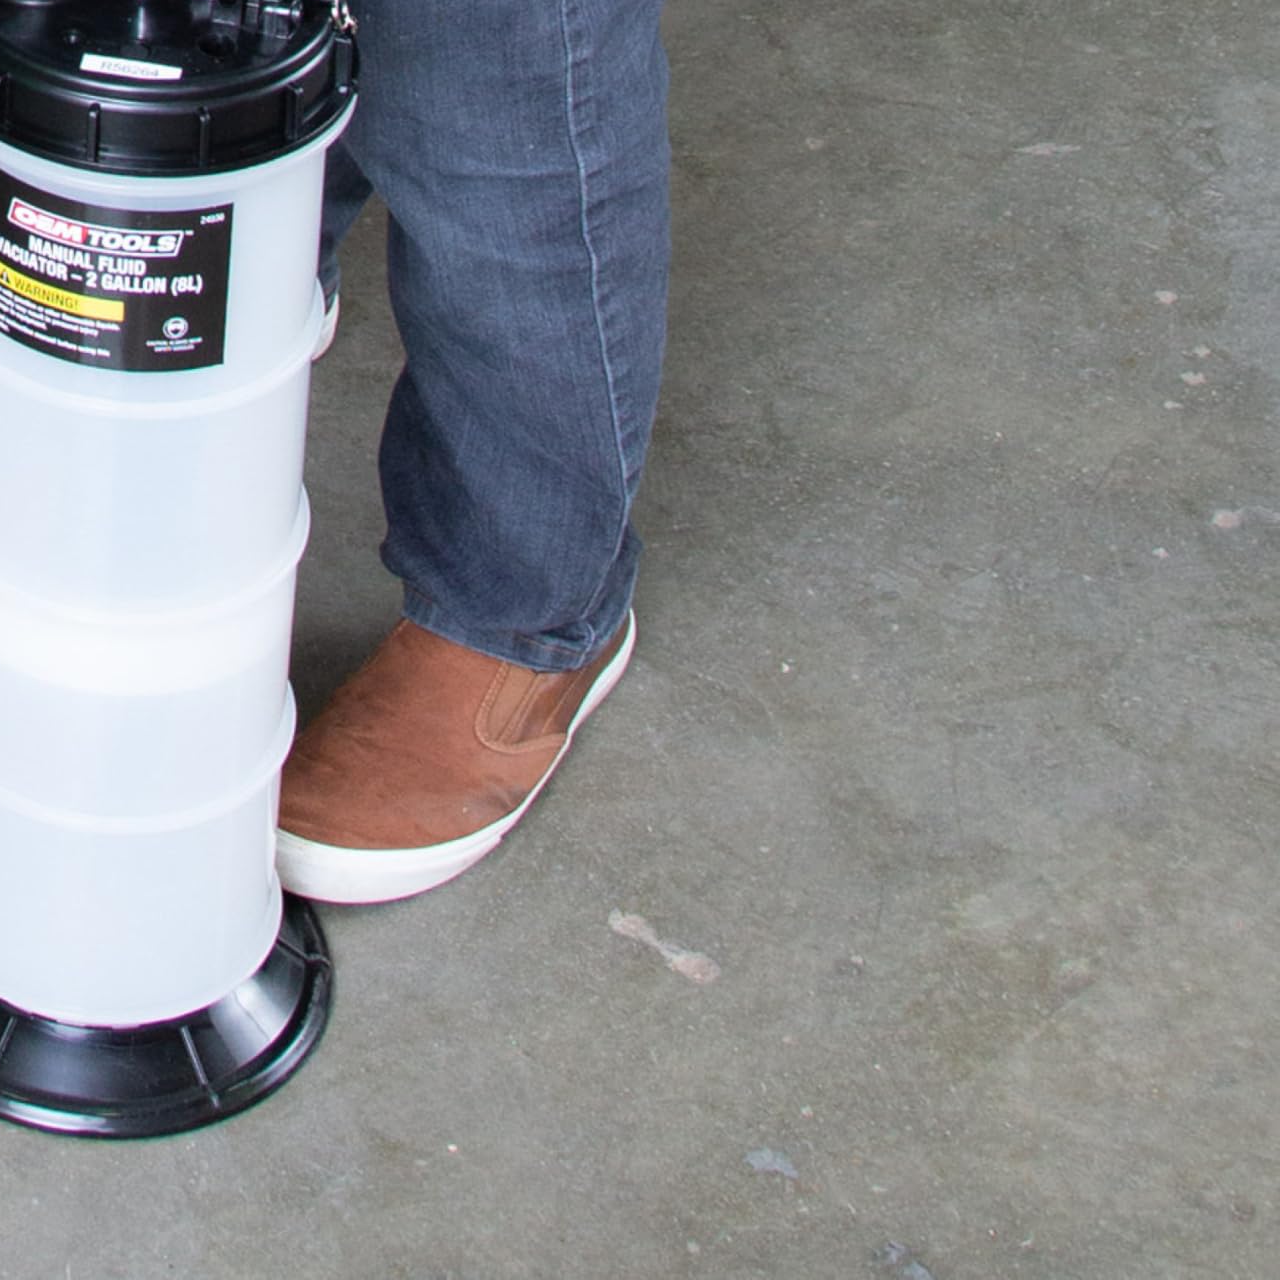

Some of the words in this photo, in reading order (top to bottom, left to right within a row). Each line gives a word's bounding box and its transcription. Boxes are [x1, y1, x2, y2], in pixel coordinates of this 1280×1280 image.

[28, 234, 94, 270] MANUAL
[98, 256, 147, 276] FLUID
[14, 275, 78, 310] WARNING!
[85, 271, 98, 288] 2
[101, 274, 167, 294] GALLON
[170, 274, 203, 297] (8L)
